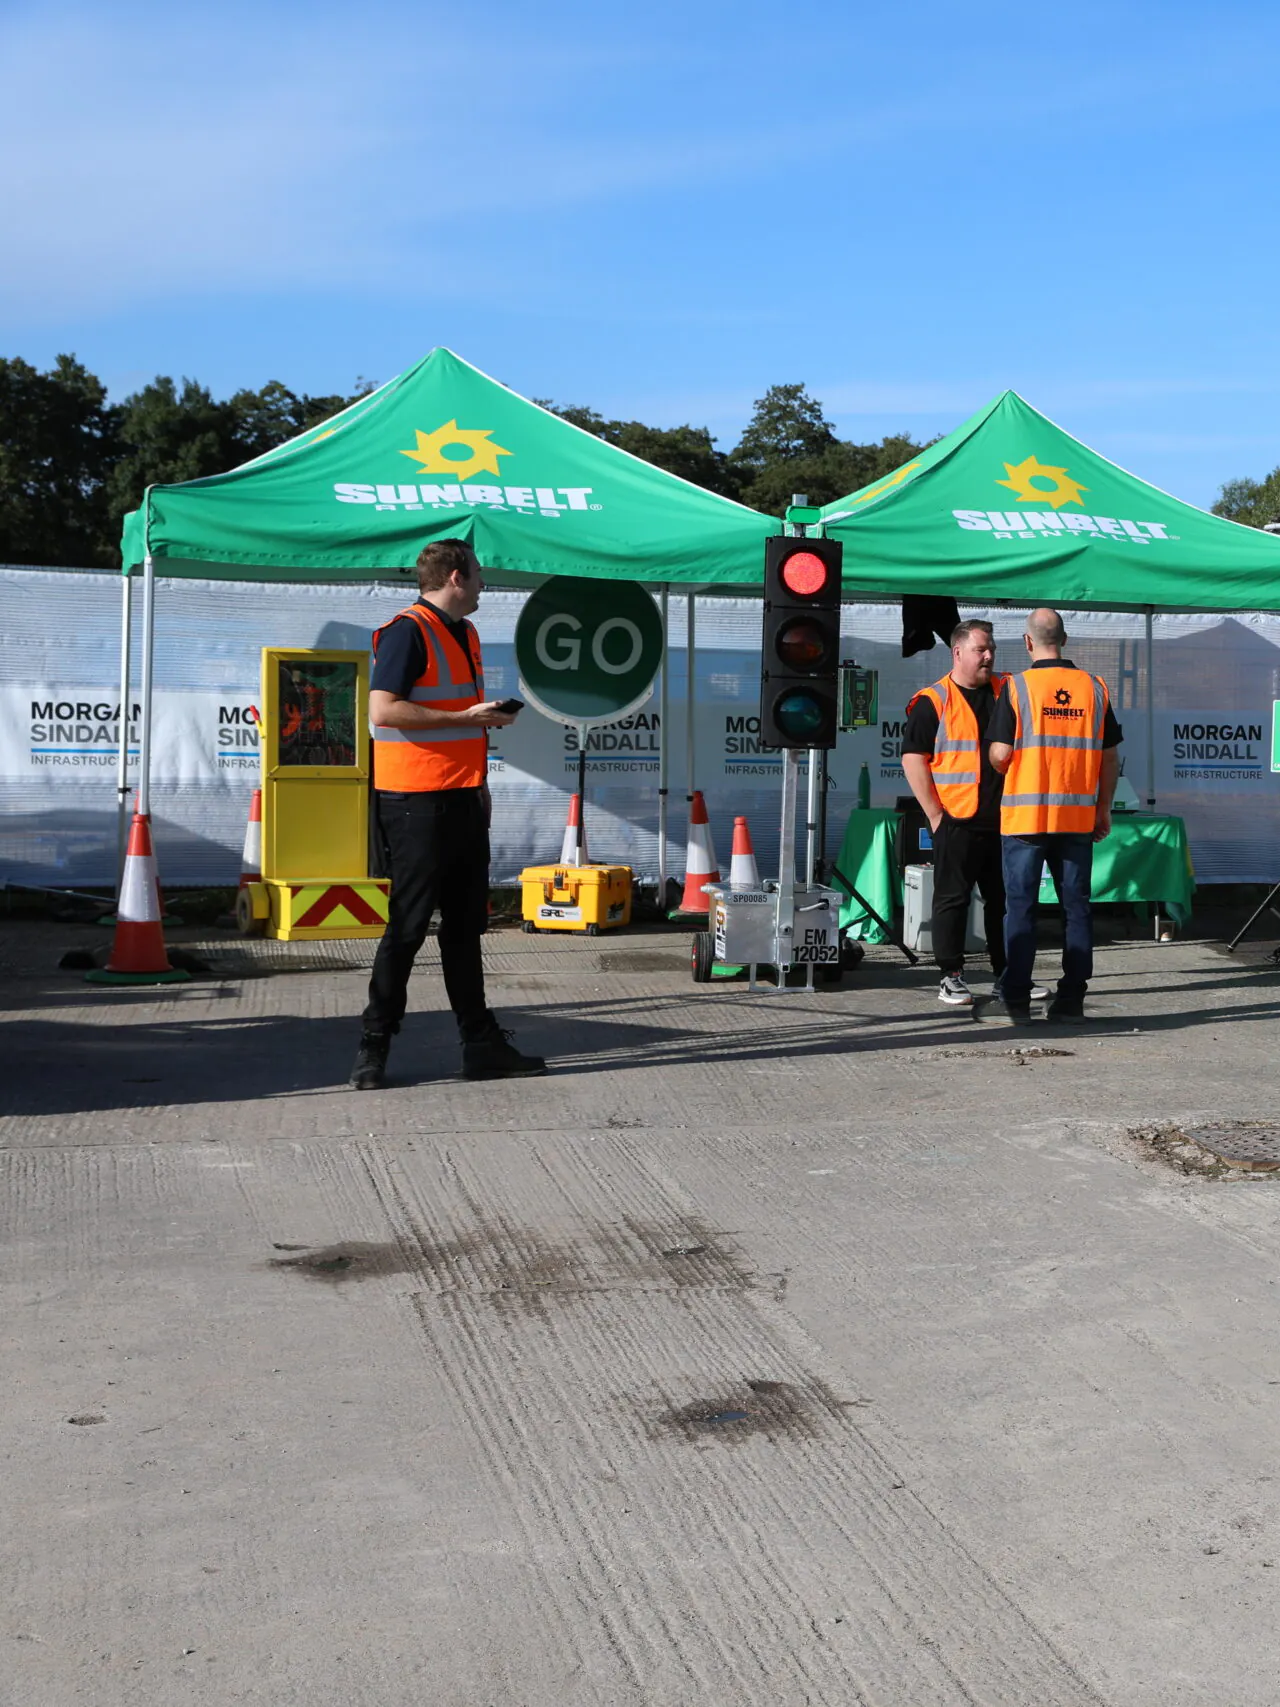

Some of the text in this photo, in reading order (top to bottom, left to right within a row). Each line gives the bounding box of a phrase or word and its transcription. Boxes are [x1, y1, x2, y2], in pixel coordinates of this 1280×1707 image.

[374, 501, 561, 518] RENTALS
[992, 529, 1151, 545] RENTALS
[535, 612, 643, 675] GO
[1042, 706, 1084, 717] SUNBELT
[1173, 723, 1262, 741] MORGAN
[564, 733, 661, 752] SNDALL
[1173, 743, 1258, 760] SINDALL
[1173, 770, 1263, 780] INFRASTRUCTURE
[733, 894, 768, 903] SP00085
[804, 929, 827, 945] EM
[793, 946, 838, 962] 12052
